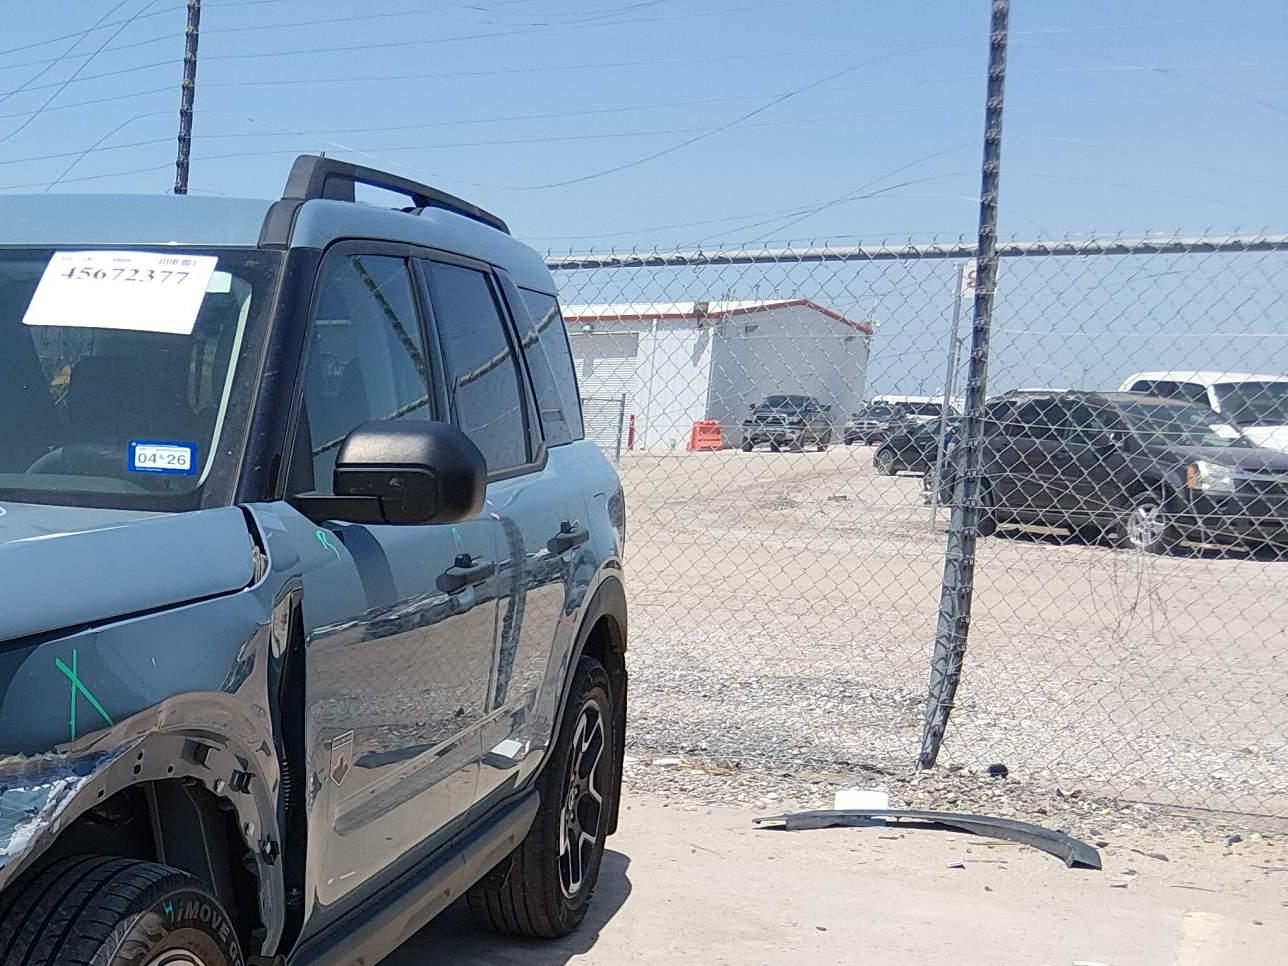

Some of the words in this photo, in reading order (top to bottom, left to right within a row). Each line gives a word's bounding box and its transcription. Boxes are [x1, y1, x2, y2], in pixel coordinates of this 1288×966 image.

[61, 267, 190, 285] 45672377
[137, 453, 157, 464] 04
[167, 454, 187, 466] 26
